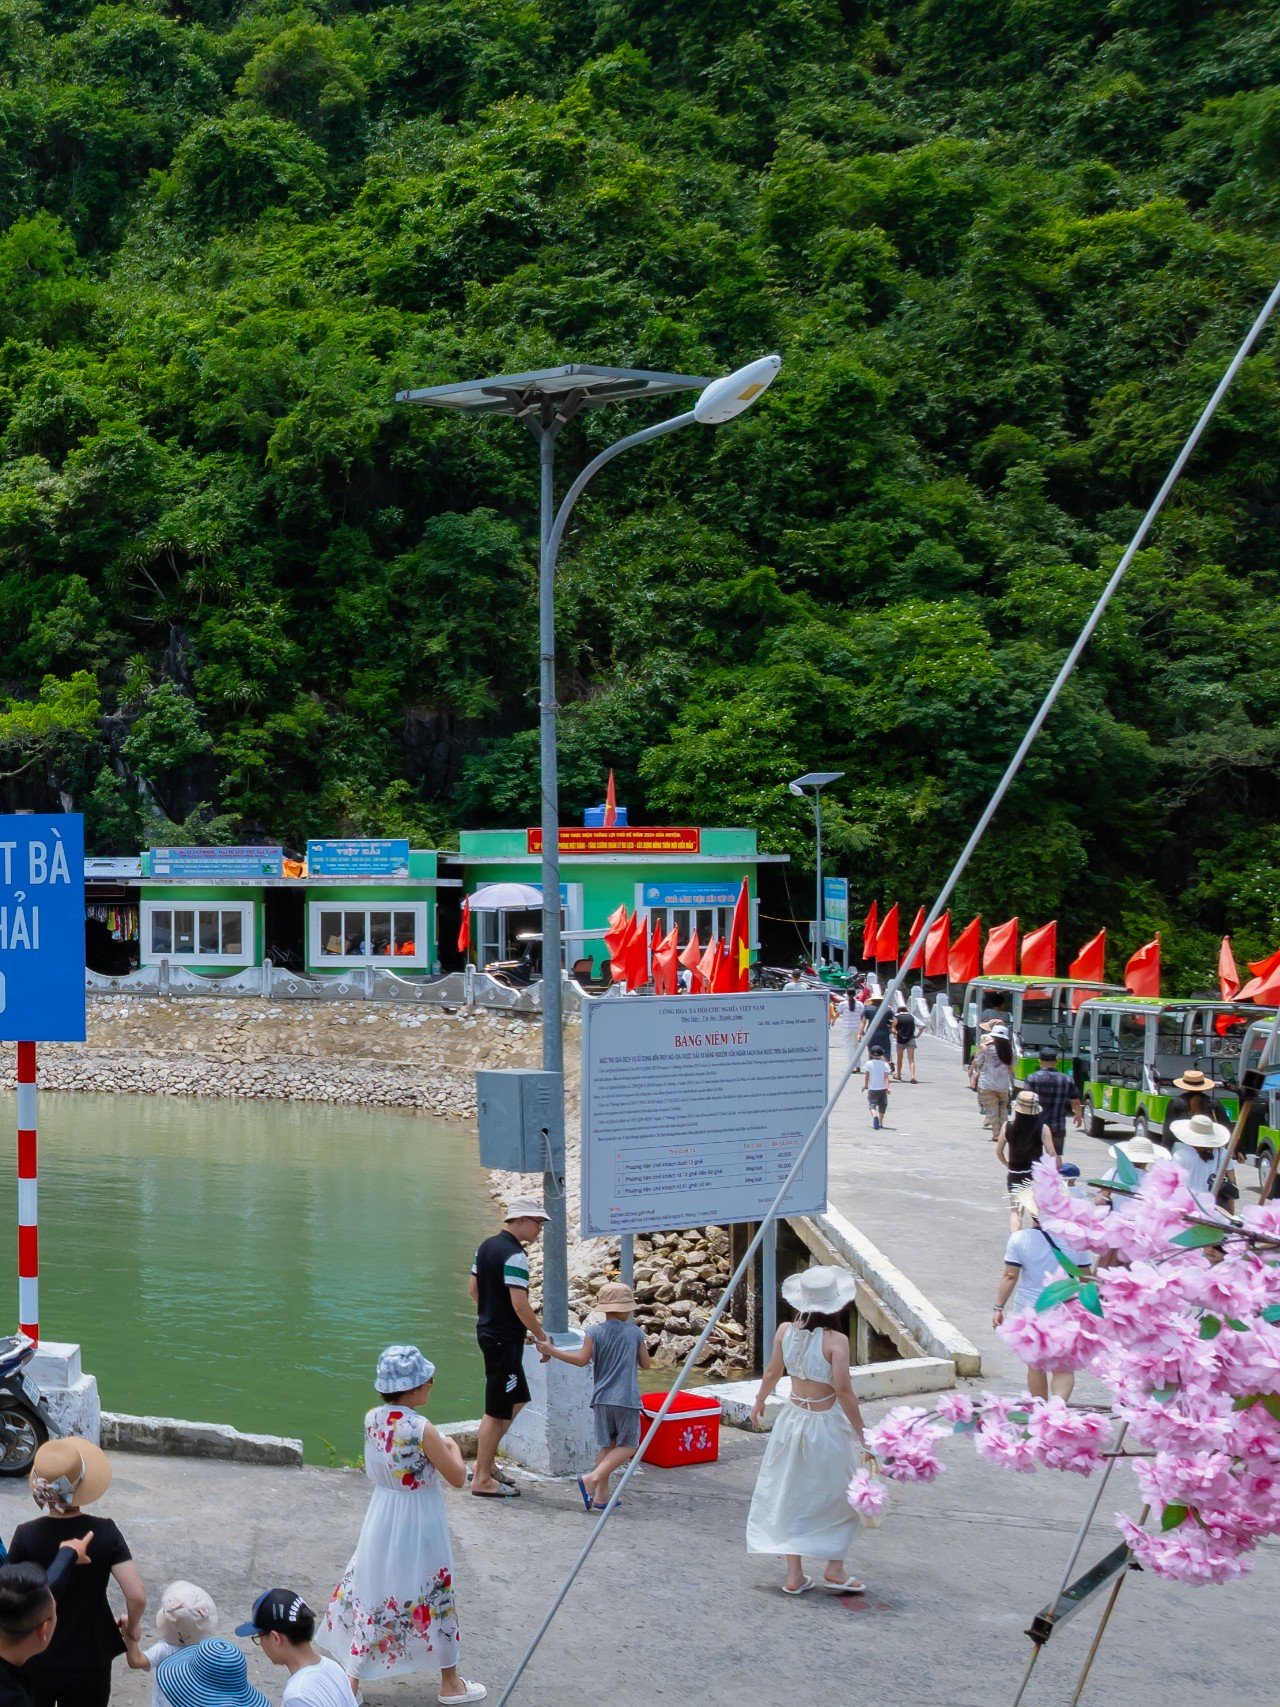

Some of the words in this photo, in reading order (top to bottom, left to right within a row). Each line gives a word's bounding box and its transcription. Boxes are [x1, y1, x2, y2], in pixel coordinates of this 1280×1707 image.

[28, 827, 71, 885] BÀ
[675, 1030, 702, 1047] BẢNG
[705, 1030, 728, 1046] NIÊM
[731, 1027, 749, 1044] YẾT
